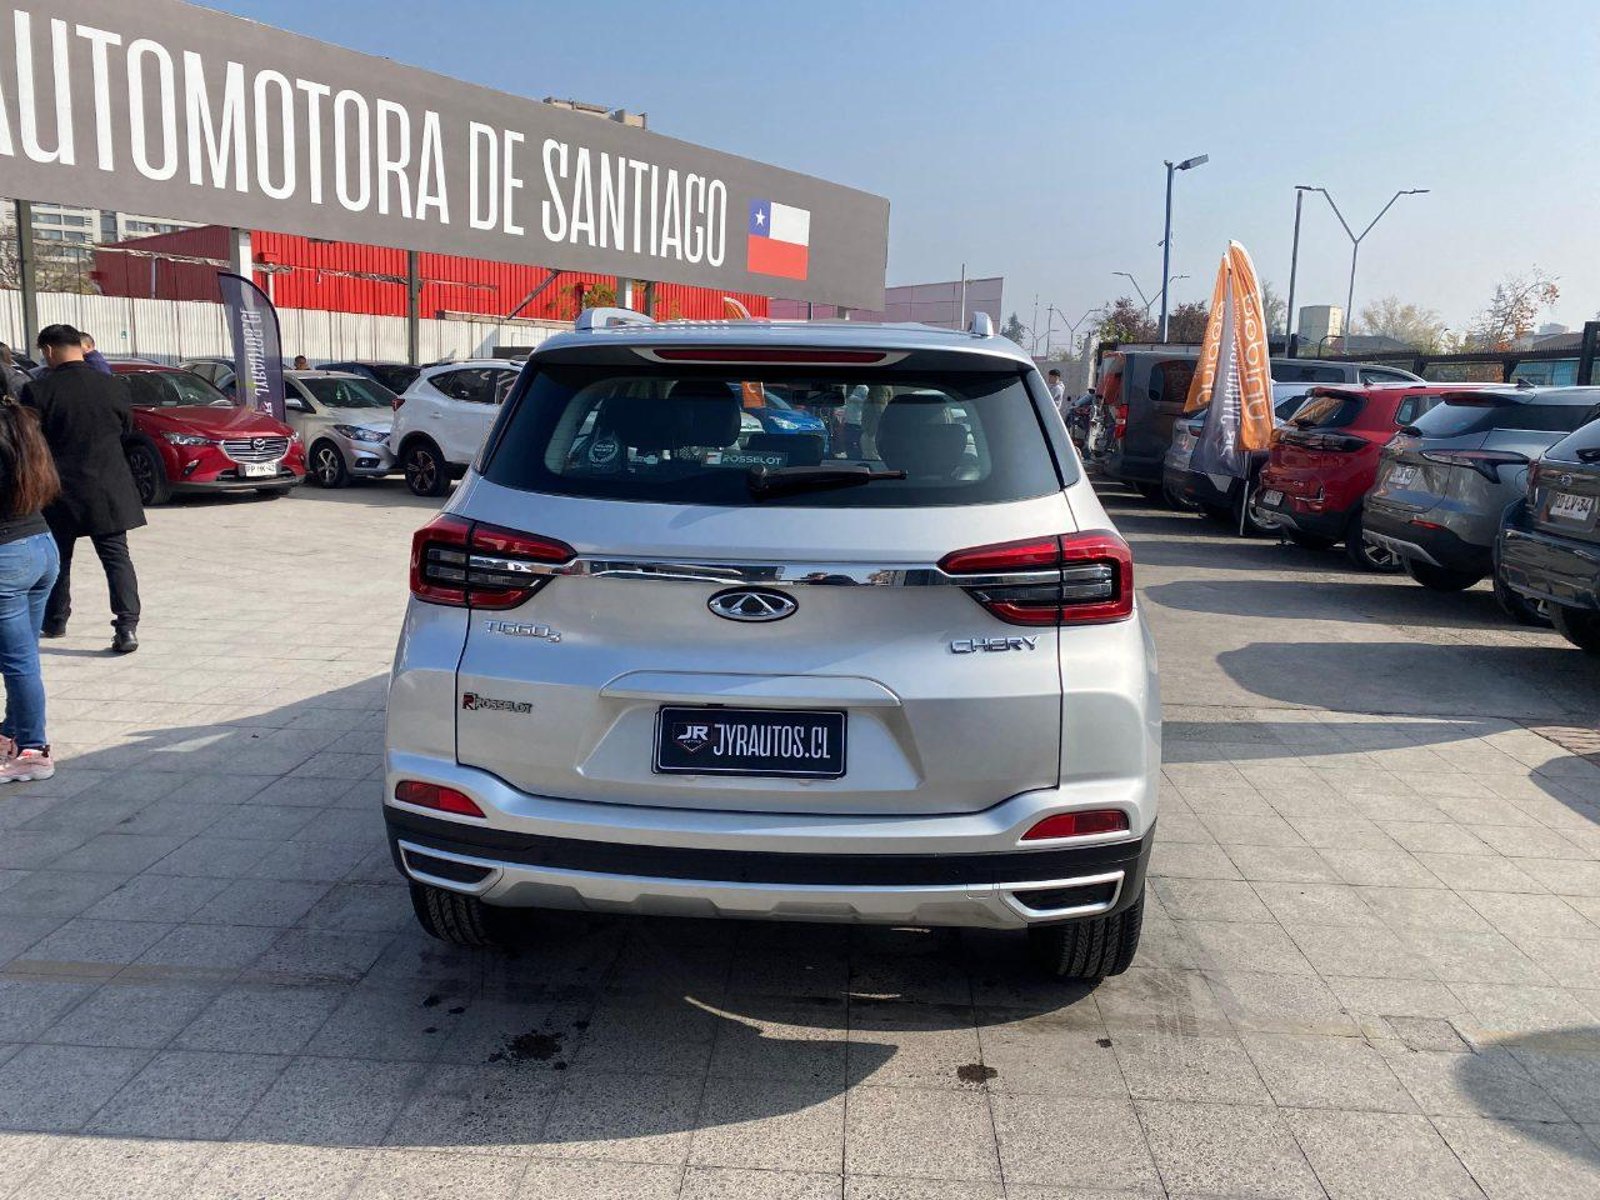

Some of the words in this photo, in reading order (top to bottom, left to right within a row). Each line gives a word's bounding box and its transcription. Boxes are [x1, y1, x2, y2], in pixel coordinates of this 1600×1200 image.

[0, 9, 450, 225] UTOMOTORA
[469, 120, 525, 236] DE
[541, 137, 727, 267] SANTIAGO
[951, 635, 1038, 654] CHERY
[677, 724, 709, 741] JR
[713, 723, 831, 759] JYRAUTOS.CL
